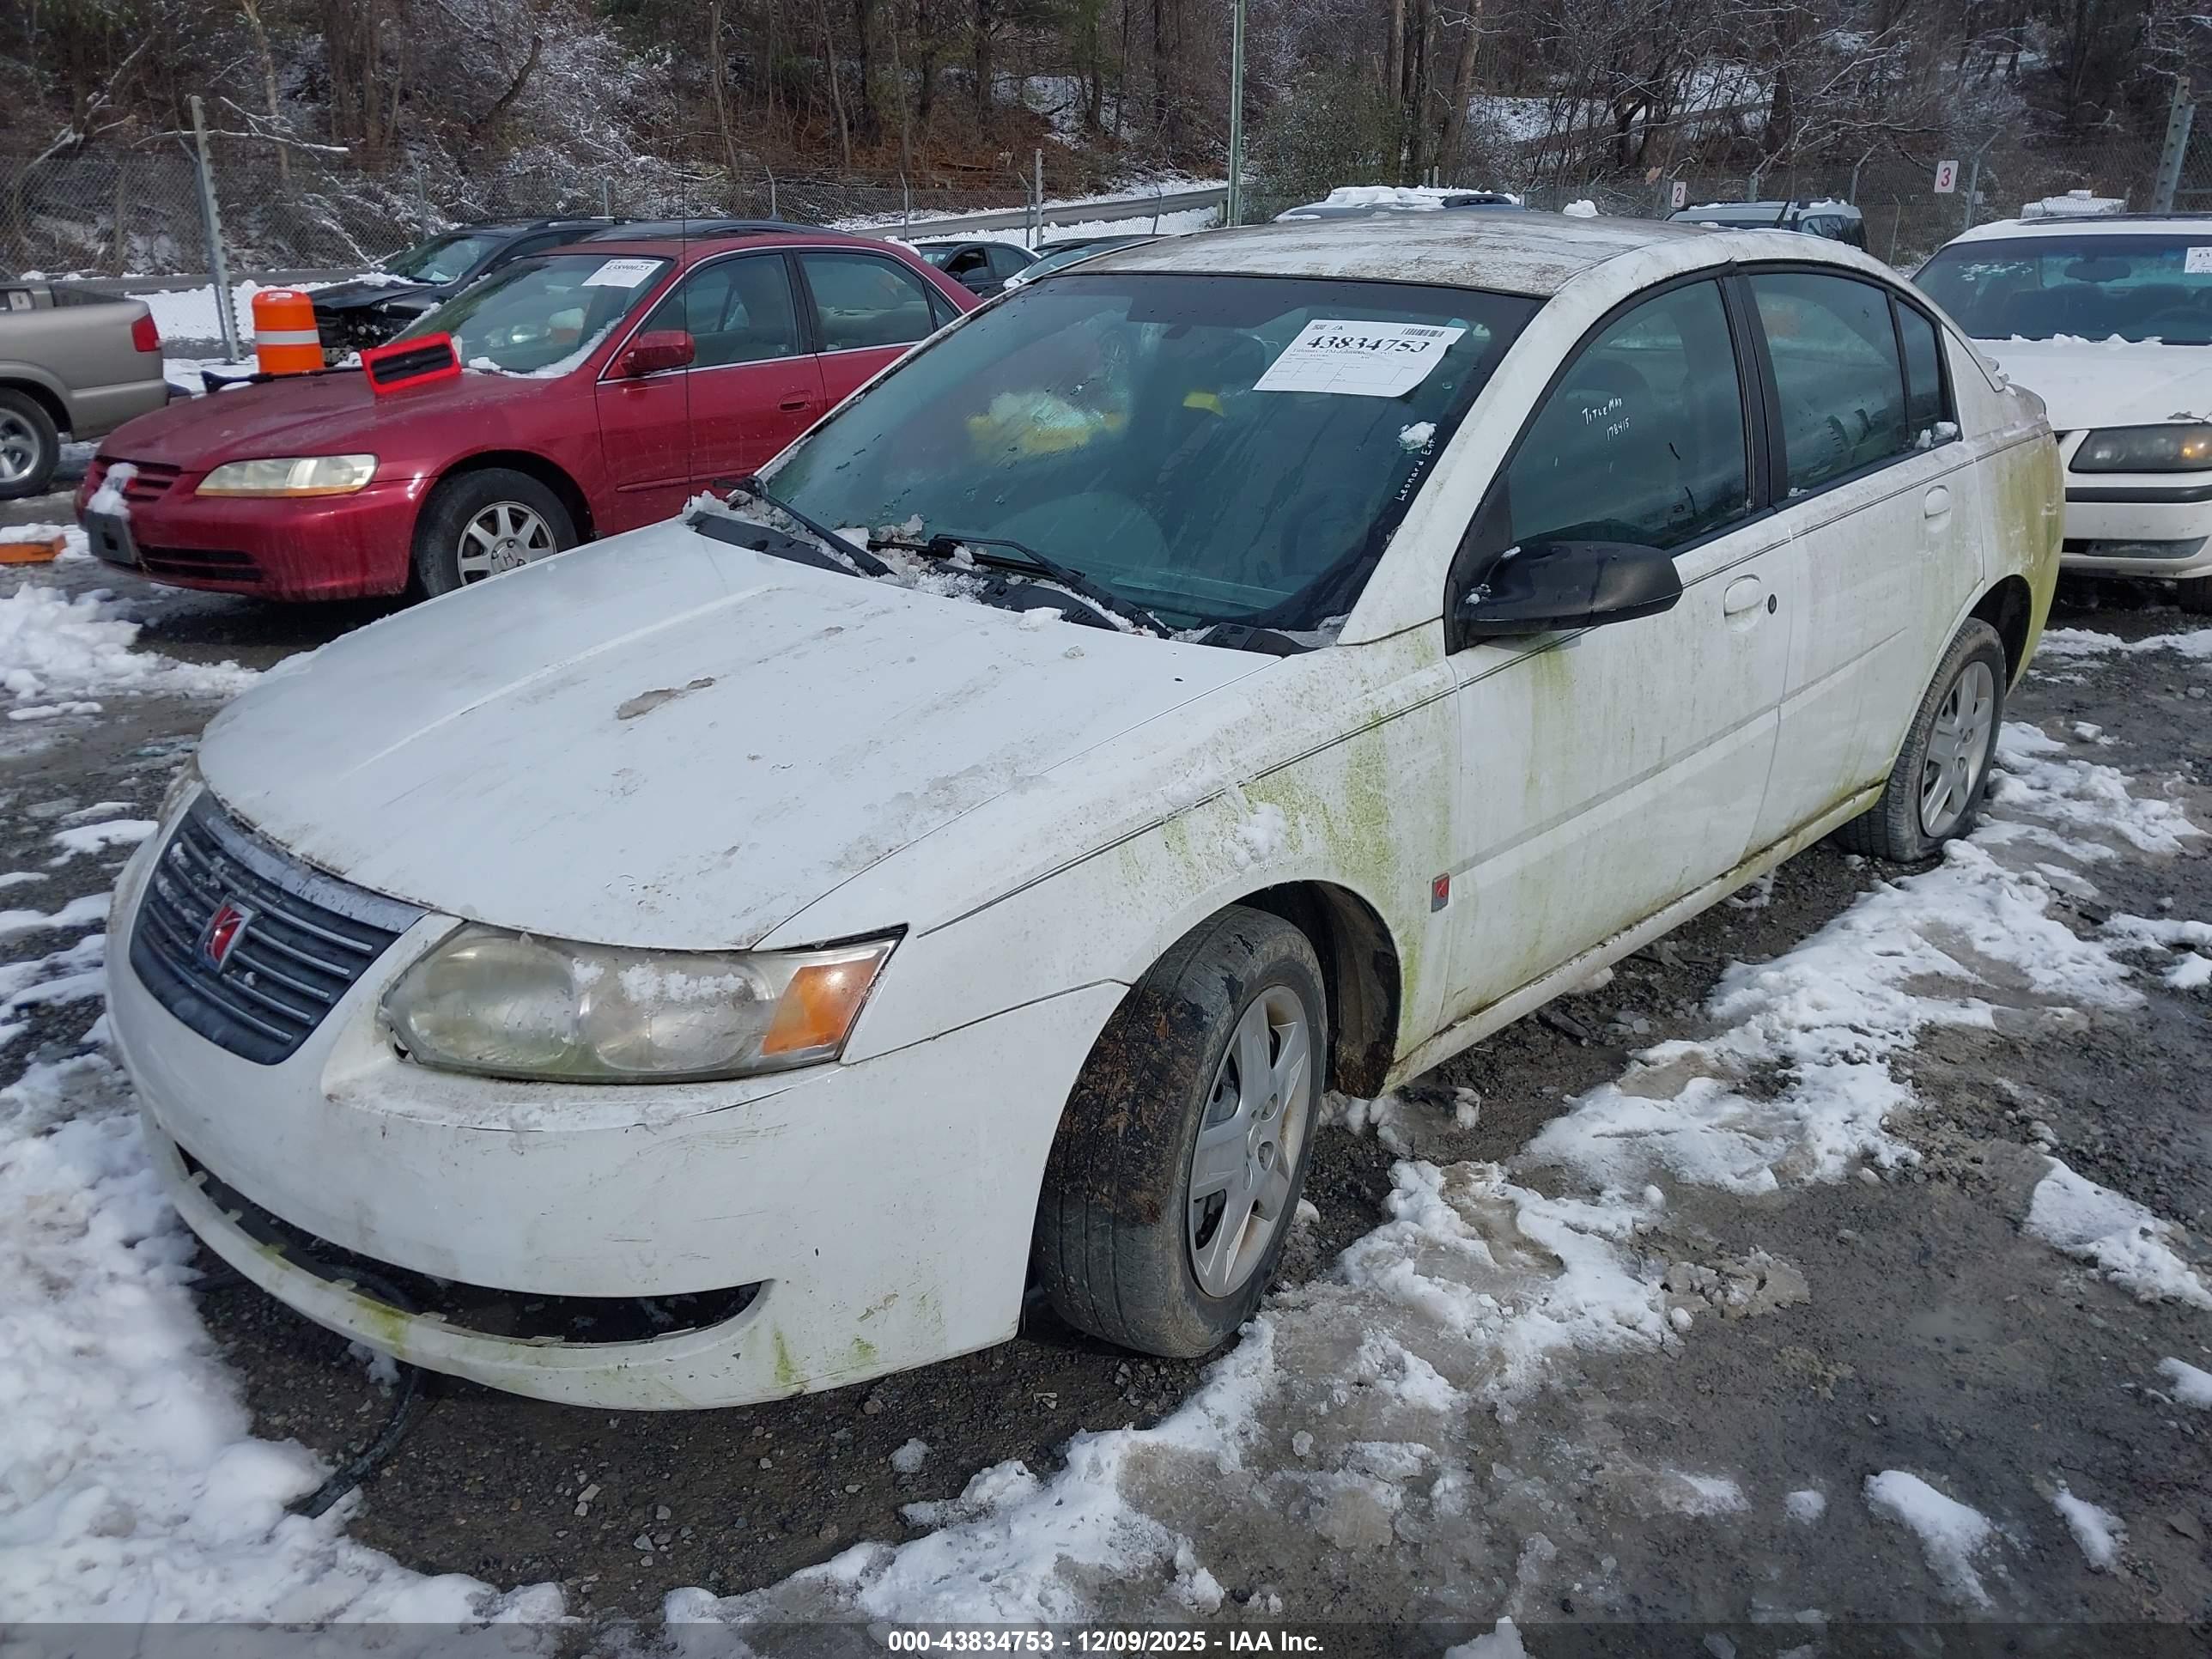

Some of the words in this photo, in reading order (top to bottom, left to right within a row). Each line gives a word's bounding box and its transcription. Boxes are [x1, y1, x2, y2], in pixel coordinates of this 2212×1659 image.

[1941, 167, 1952, 187] 3
[1675, 186, 1682, 203] 2
[1307, 334, 1431, 354] 43834753
[1607, 417, 1630, 441] 178415
[1395, 460, 1425, 501] Leonard
